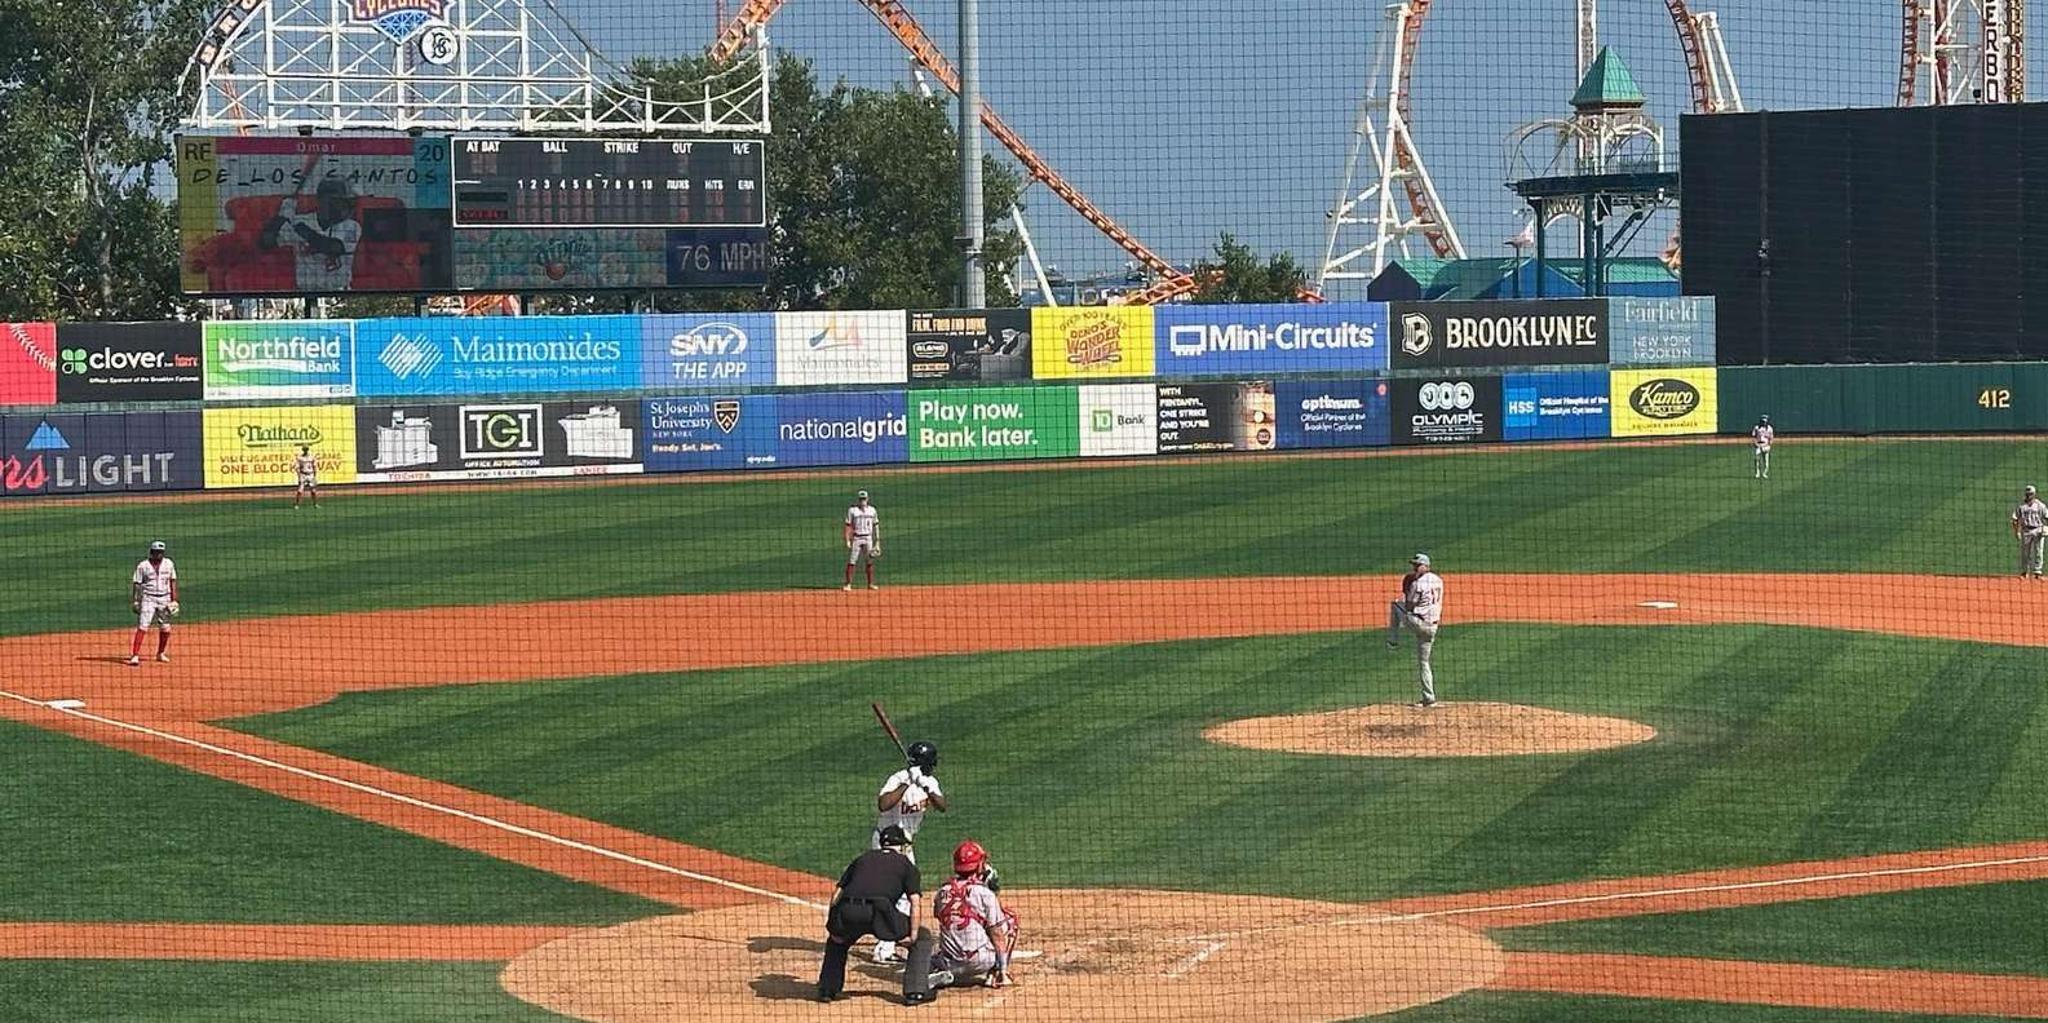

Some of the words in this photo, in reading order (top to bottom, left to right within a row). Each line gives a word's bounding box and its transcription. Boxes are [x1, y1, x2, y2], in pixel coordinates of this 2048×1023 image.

[419, 145, 444, 162] 20
[466, 141, 480, 152] AT
[481, 141, 500, 152] BAT
[543, 141, 568, 152] BALL
[604, 142, 639, 153] STRIKE
[672, 142, 692, 154] OUT
[733, 143, 750, 154] H/E
[518, 180, 523, 189] 1
[530, 180, 537, 189] 2
[544, 180, 550, 189] 3
[560, 180, 566, 189] 4
[573, 180, 580, 189] 5
[586, 180, 592, 189] 6
[602, 180, 608, 189] 7
[676, 245, 710, 271] 76
[721, 243, 766, 271] MPH
[1625, 299, 1697, 322] Fairfield
[1210, 322, 1375, 351] Mini-Circuits
[1447, 315, 1574, 348] BROOKLYN
[1576, 315, 1596, 338] FC
[219, 335, 341, 359] Northfield
[452, 332, 621, 363] Maimonides
[670, 333, 735, 356] SNY
[89, 347, 164, 369] clover
[308, 359, 340, 373] Bank
[673, 361, 708, 379] THE
[714, 361, 747, 379] APP
[1639, 382, 1693, 407] Kamco
[1978, 389, 2011, 408] 412
[919, 400, 968, 424] Play
[972, 401, 1024, 418] now.
[1508, 401, 1535, 414] HSS
[651, 416, 714, 430] University
[1117, 413, 1146, 426] Bank
[1412, 409, 1483, 426] OLYMPIC
[238, 424, 322, 442] Nathan's
[469, 413, 533, 449] TGI
[780, 412, 907, 443] nationalgrid
[919, 427, 977, 449] Bank
[981, 426, 1038, 447] later.
[56, 453, 175, 487] LIGHT
[220, 463, 249, 475] ONE
[253, 463, 298, 474] BLOCK
